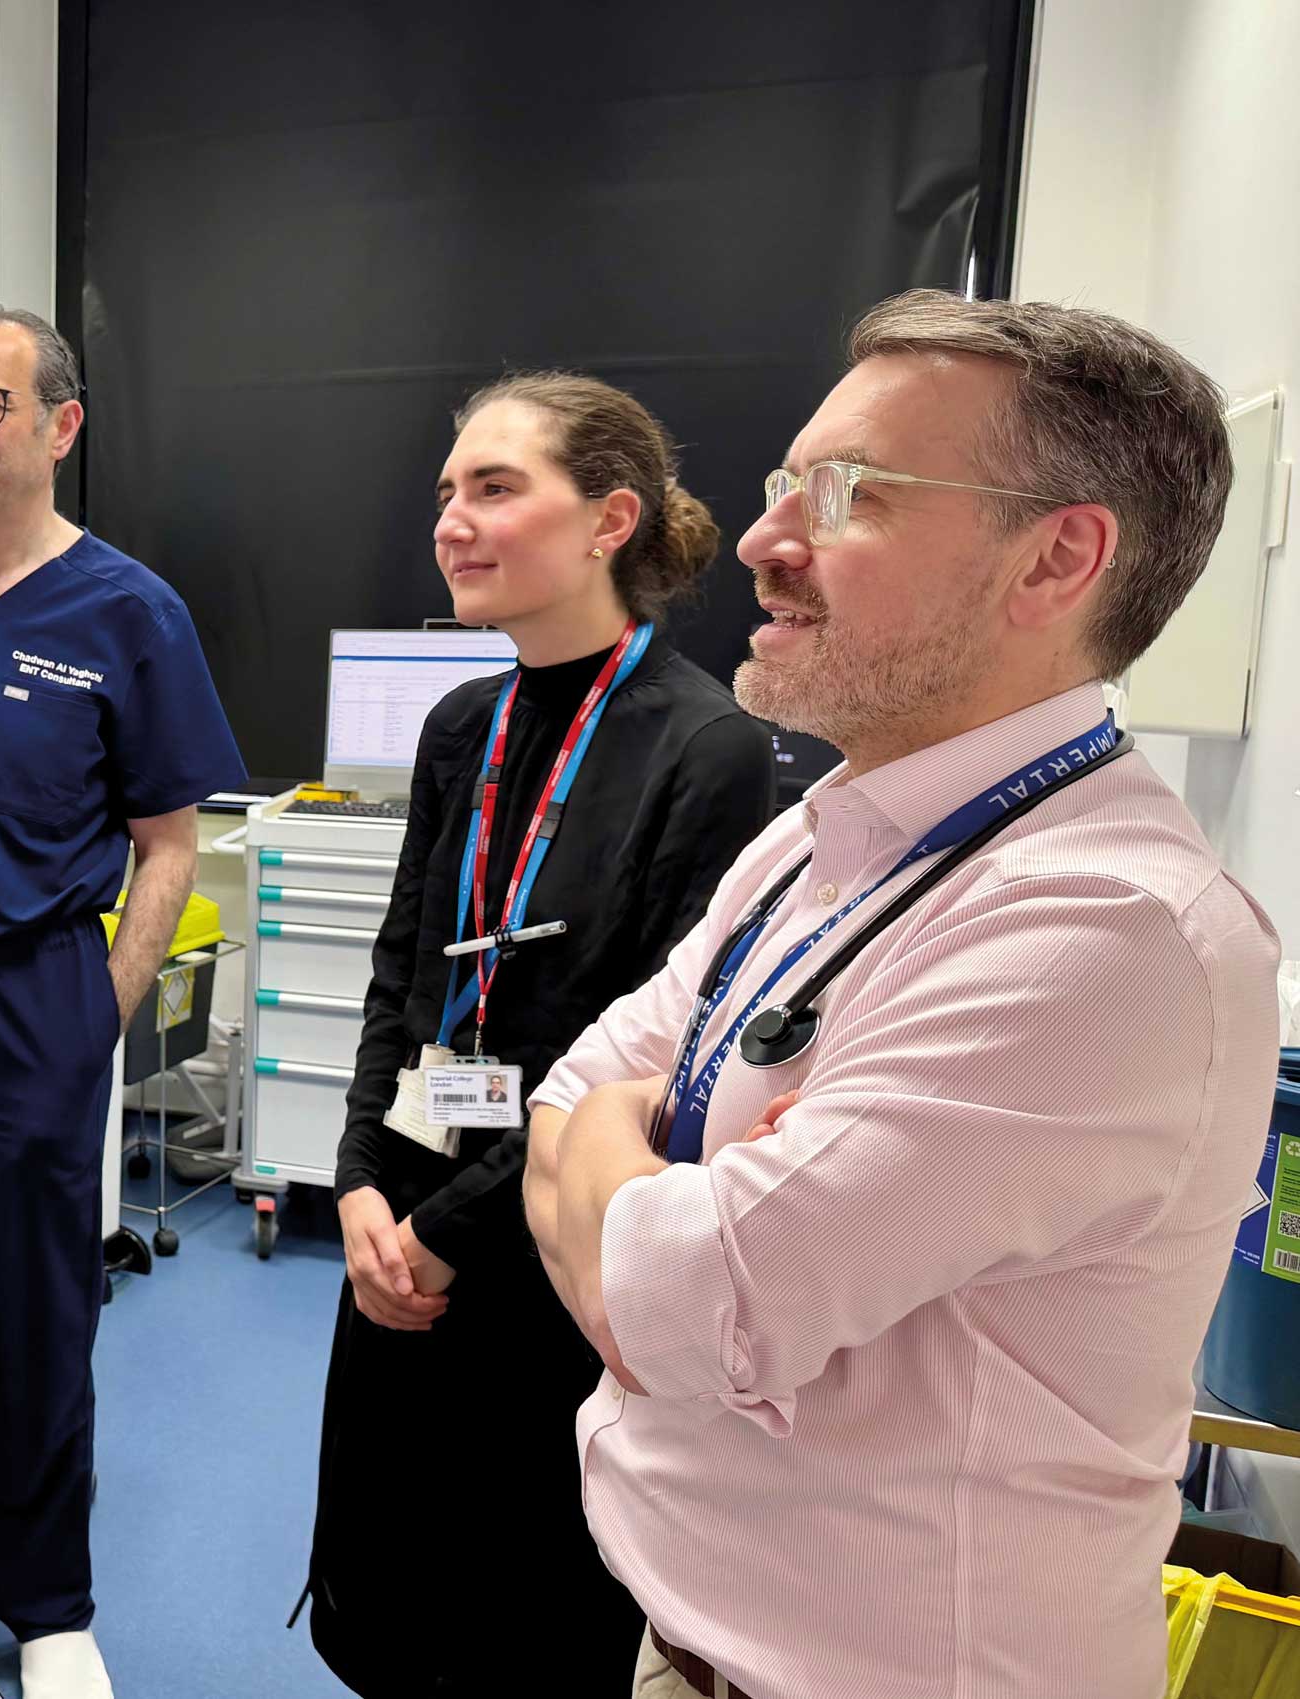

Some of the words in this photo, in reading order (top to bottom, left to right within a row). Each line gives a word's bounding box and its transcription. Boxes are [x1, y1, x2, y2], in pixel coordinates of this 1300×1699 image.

[12, 650, 56, 669] Chadwan
[56, 662, 68, 673] Al
[68, 665, 104, 683] Yaghchi
[19, 663, 40, 676] ENT
[40, 668, 92, 689] Consultant
[988, 727, 1117, 809] IMPERIAL
